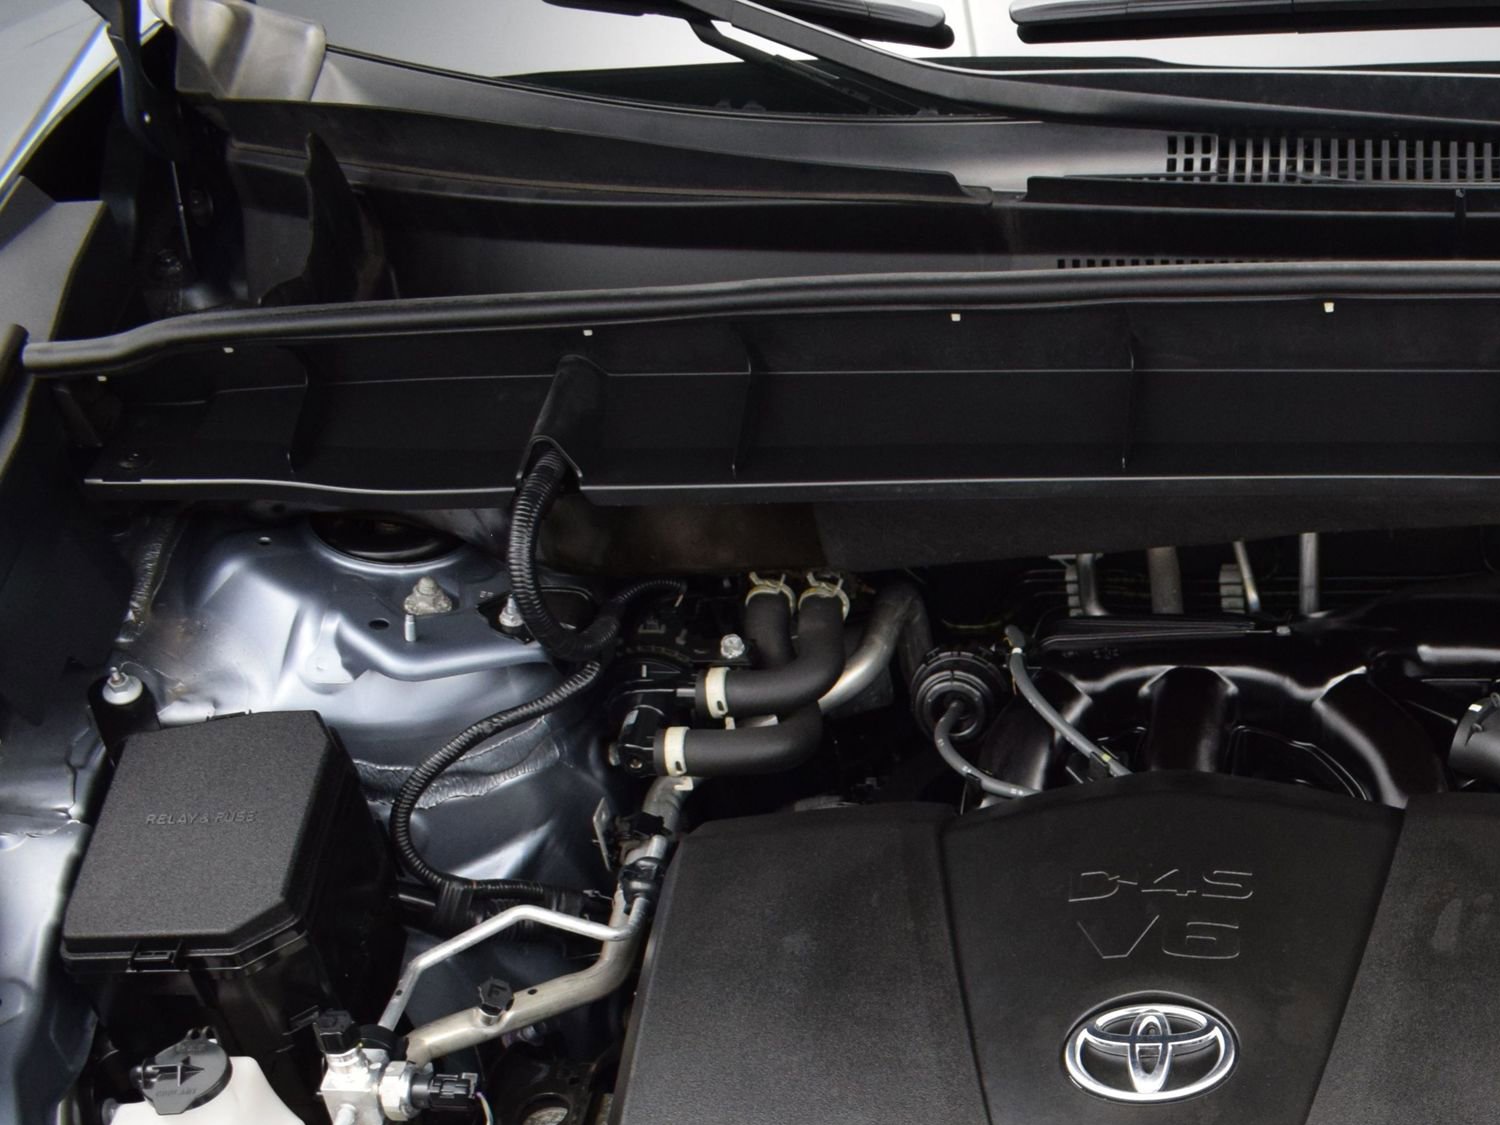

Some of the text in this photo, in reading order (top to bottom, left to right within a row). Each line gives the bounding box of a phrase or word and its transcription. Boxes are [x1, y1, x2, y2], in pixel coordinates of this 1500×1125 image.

[146, 813, 198, 825] RELAY
[215, 810, 257, 823] FUSE
[1077, 914, 1240, 960] V6
